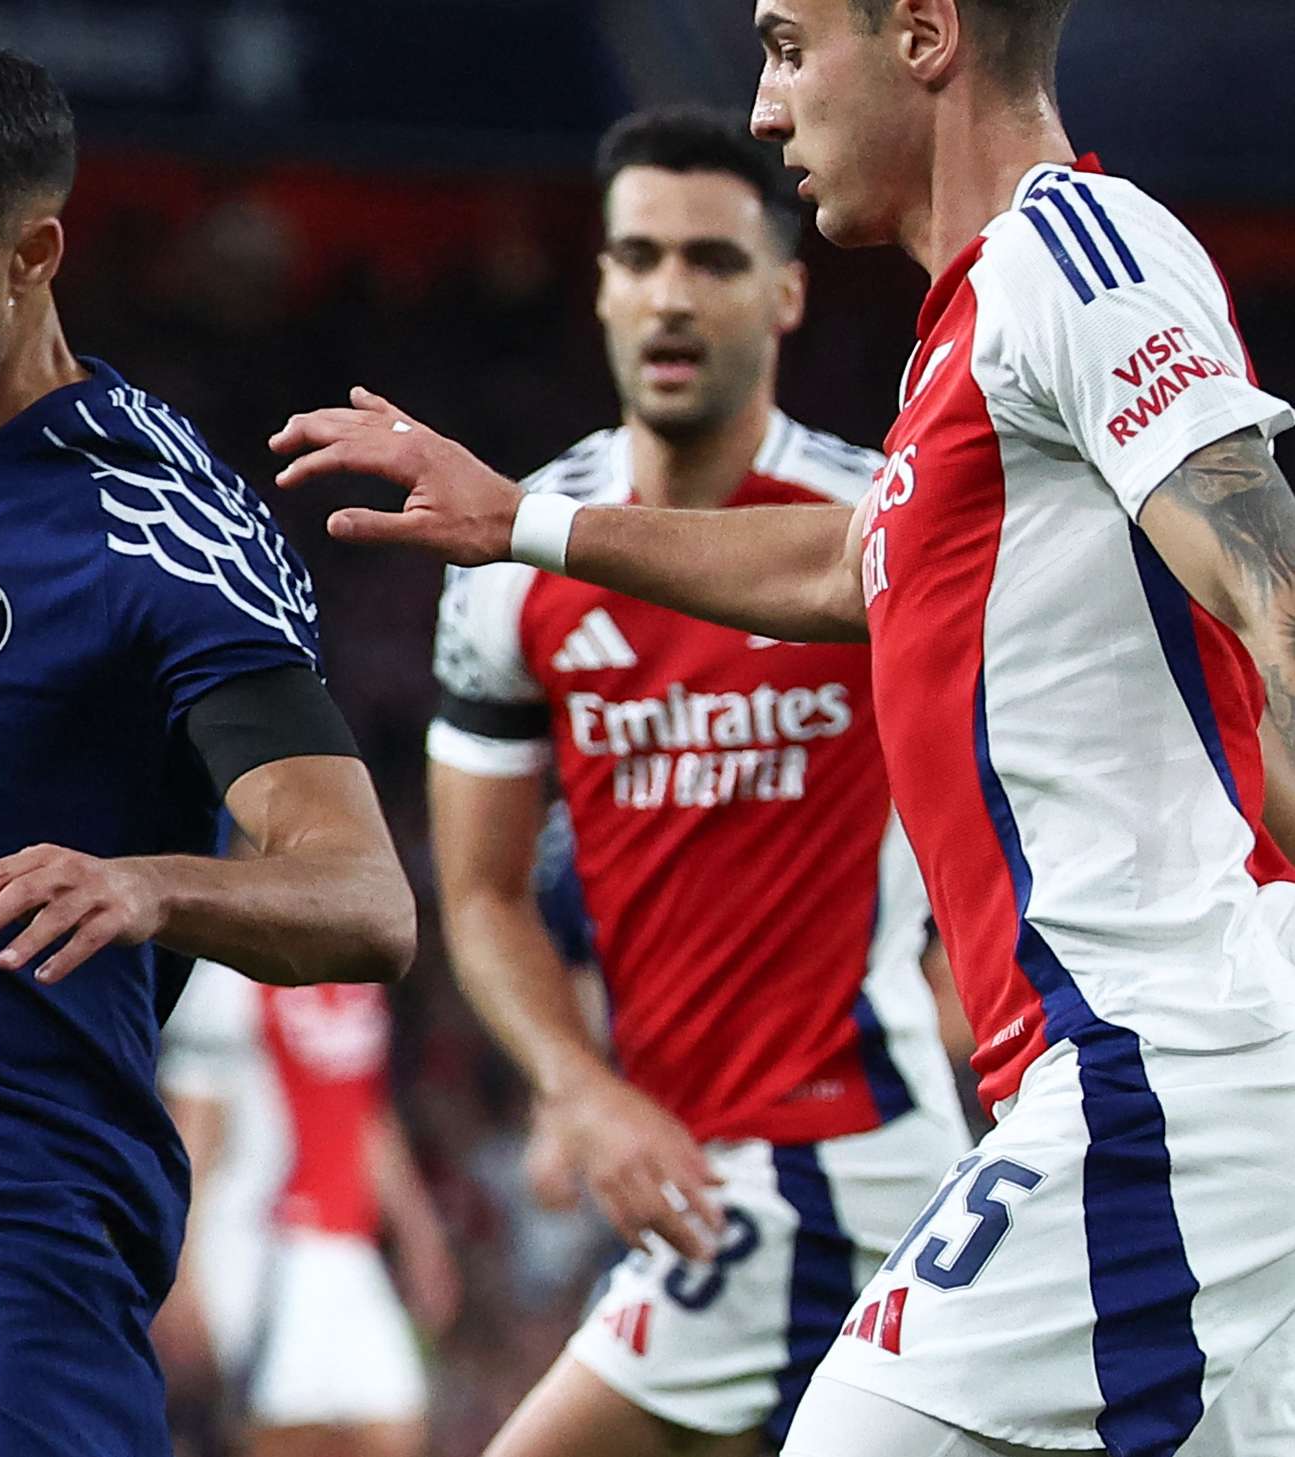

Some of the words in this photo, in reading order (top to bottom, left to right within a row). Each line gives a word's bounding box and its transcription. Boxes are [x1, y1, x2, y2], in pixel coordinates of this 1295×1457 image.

[1112, 326, 1193, 388] VISIT
[566, 682, 853, 758] Emirates
[883, 1153, 1049, 1293] 15
